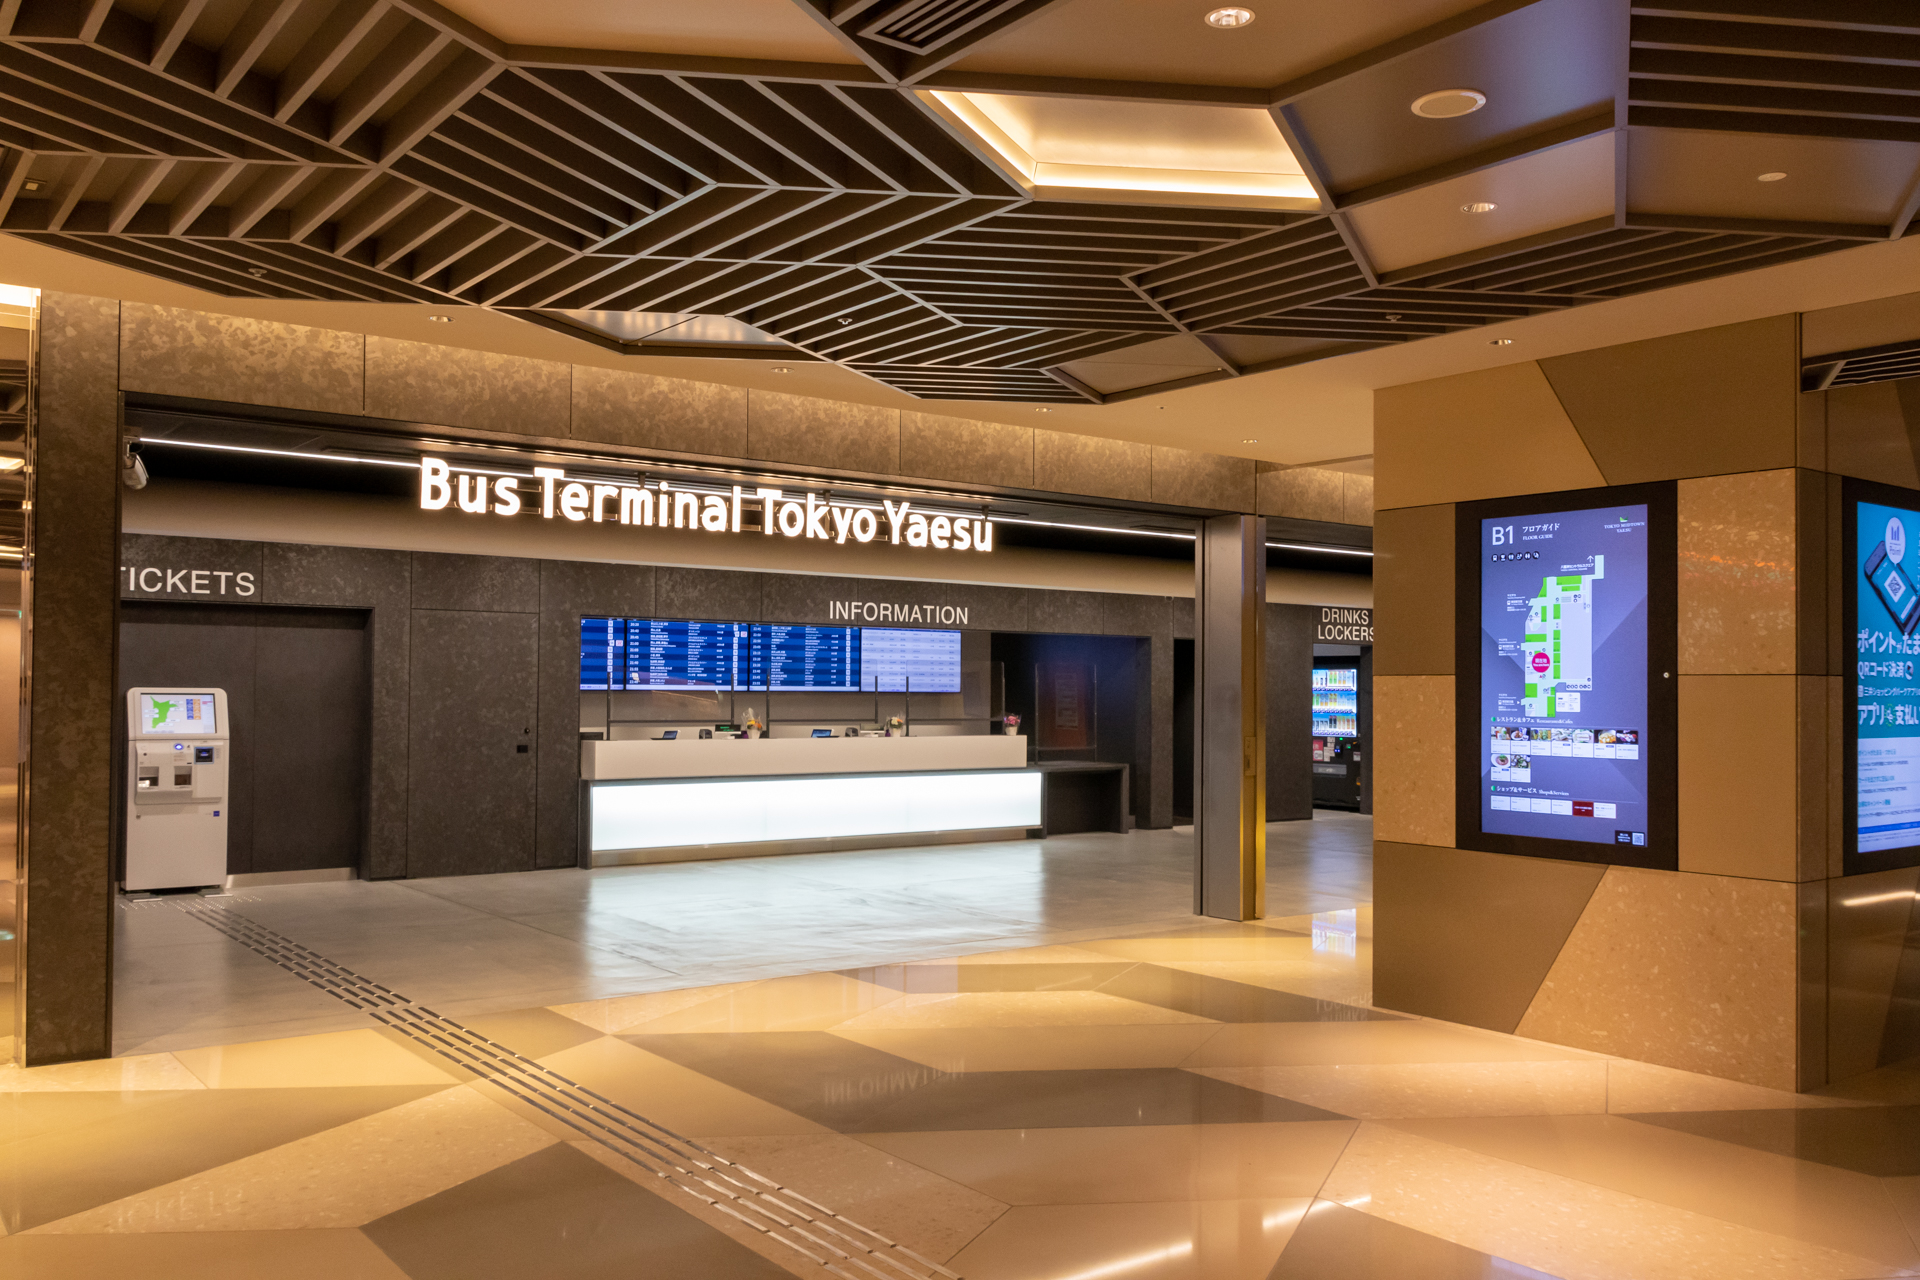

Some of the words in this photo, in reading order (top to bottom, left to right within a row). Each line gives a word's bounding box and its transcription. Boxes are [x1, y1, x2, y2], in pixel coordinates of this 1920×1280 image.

[420, 457, 521, 516] Bus
[533, 467, 742, 533] Terminal
[756, 487, 878, 545] Tokyo
[883, 500, 993, 552] Yaesu
[1492, 525, 1514, 545] B1
[1522, 522, 1560, 533] フロアガイド
[120, 566, 255, 596] ICKETS
[829, 600, 968, 625] INFORMATION
[1322, 607, 1369, 625] DRINKS
[1857, 661, 1905, 680] QRコード決済
